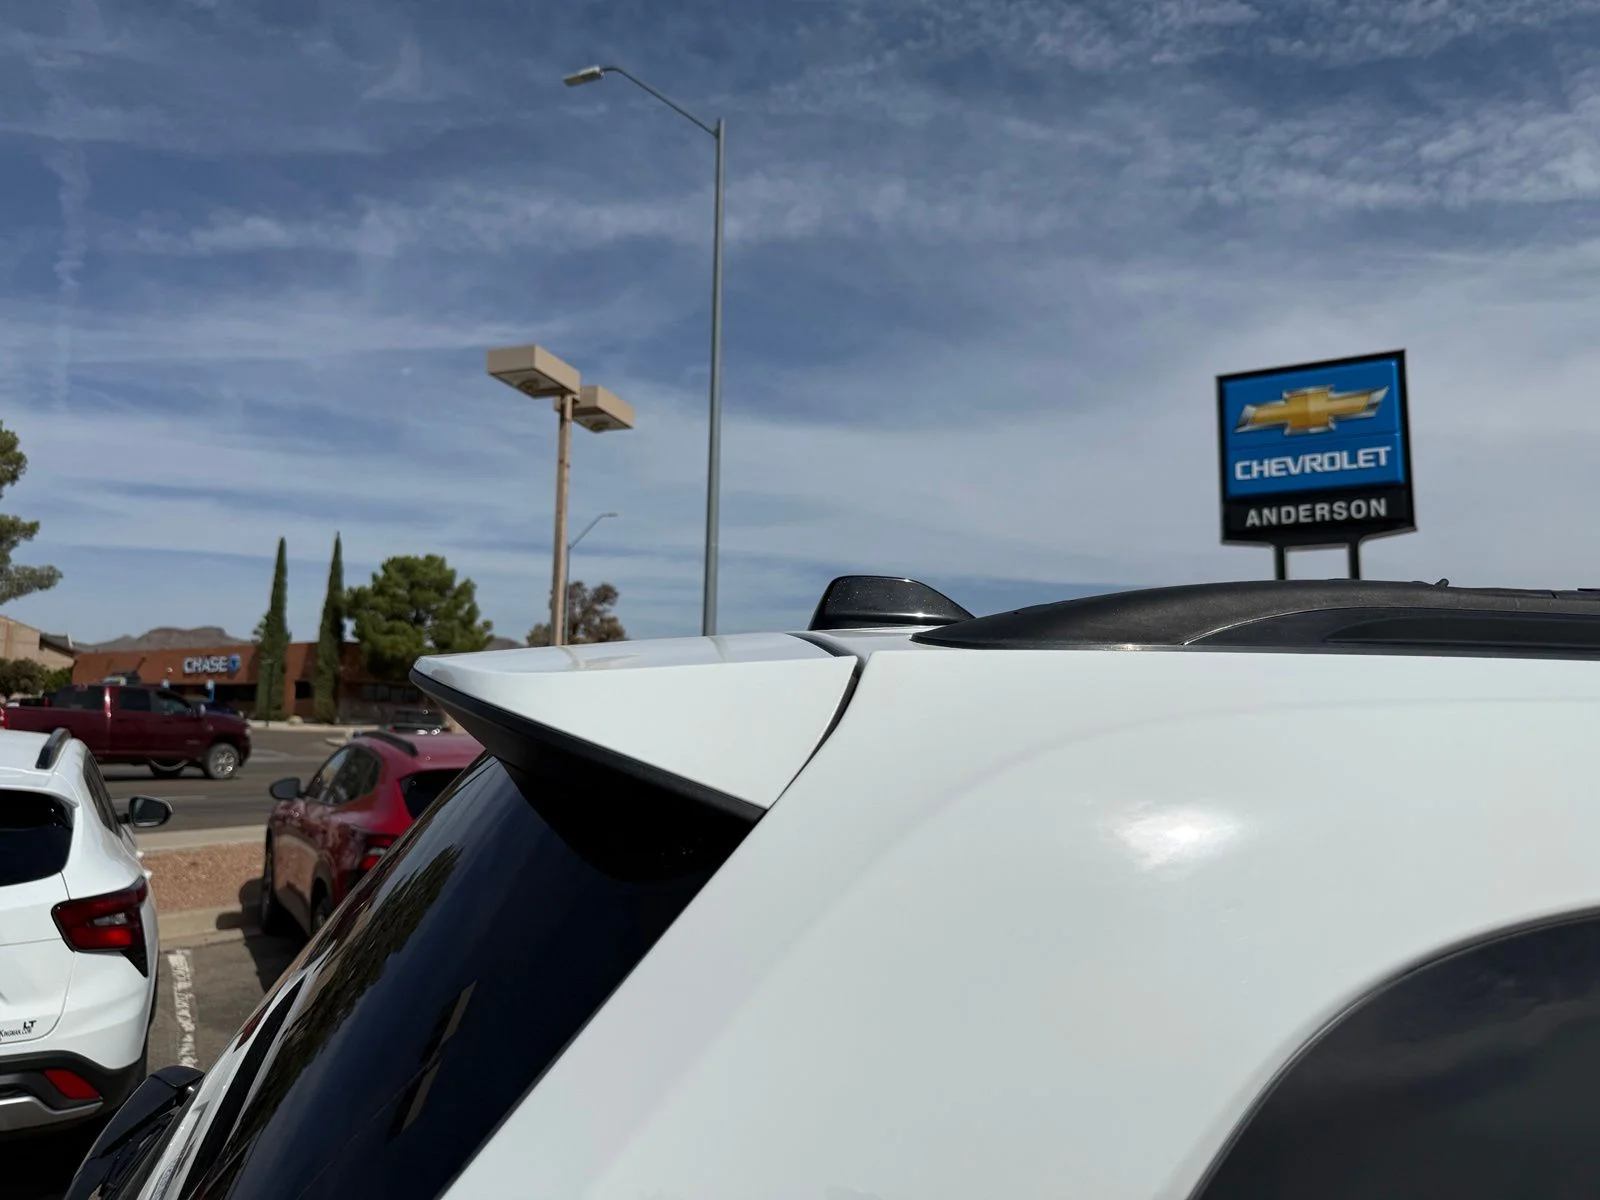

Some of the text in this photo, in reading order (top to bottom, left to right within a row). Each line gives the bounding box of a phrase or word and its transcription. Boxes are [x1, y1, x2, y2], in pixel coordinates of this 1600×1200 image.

[1234, 446, 1391, 480] CHEVROLET
[1245, 498, 1388, 528] ANDERSON
[183, 656, 228, 673] CHASE
[23, 1020, 37, 1029] LT
